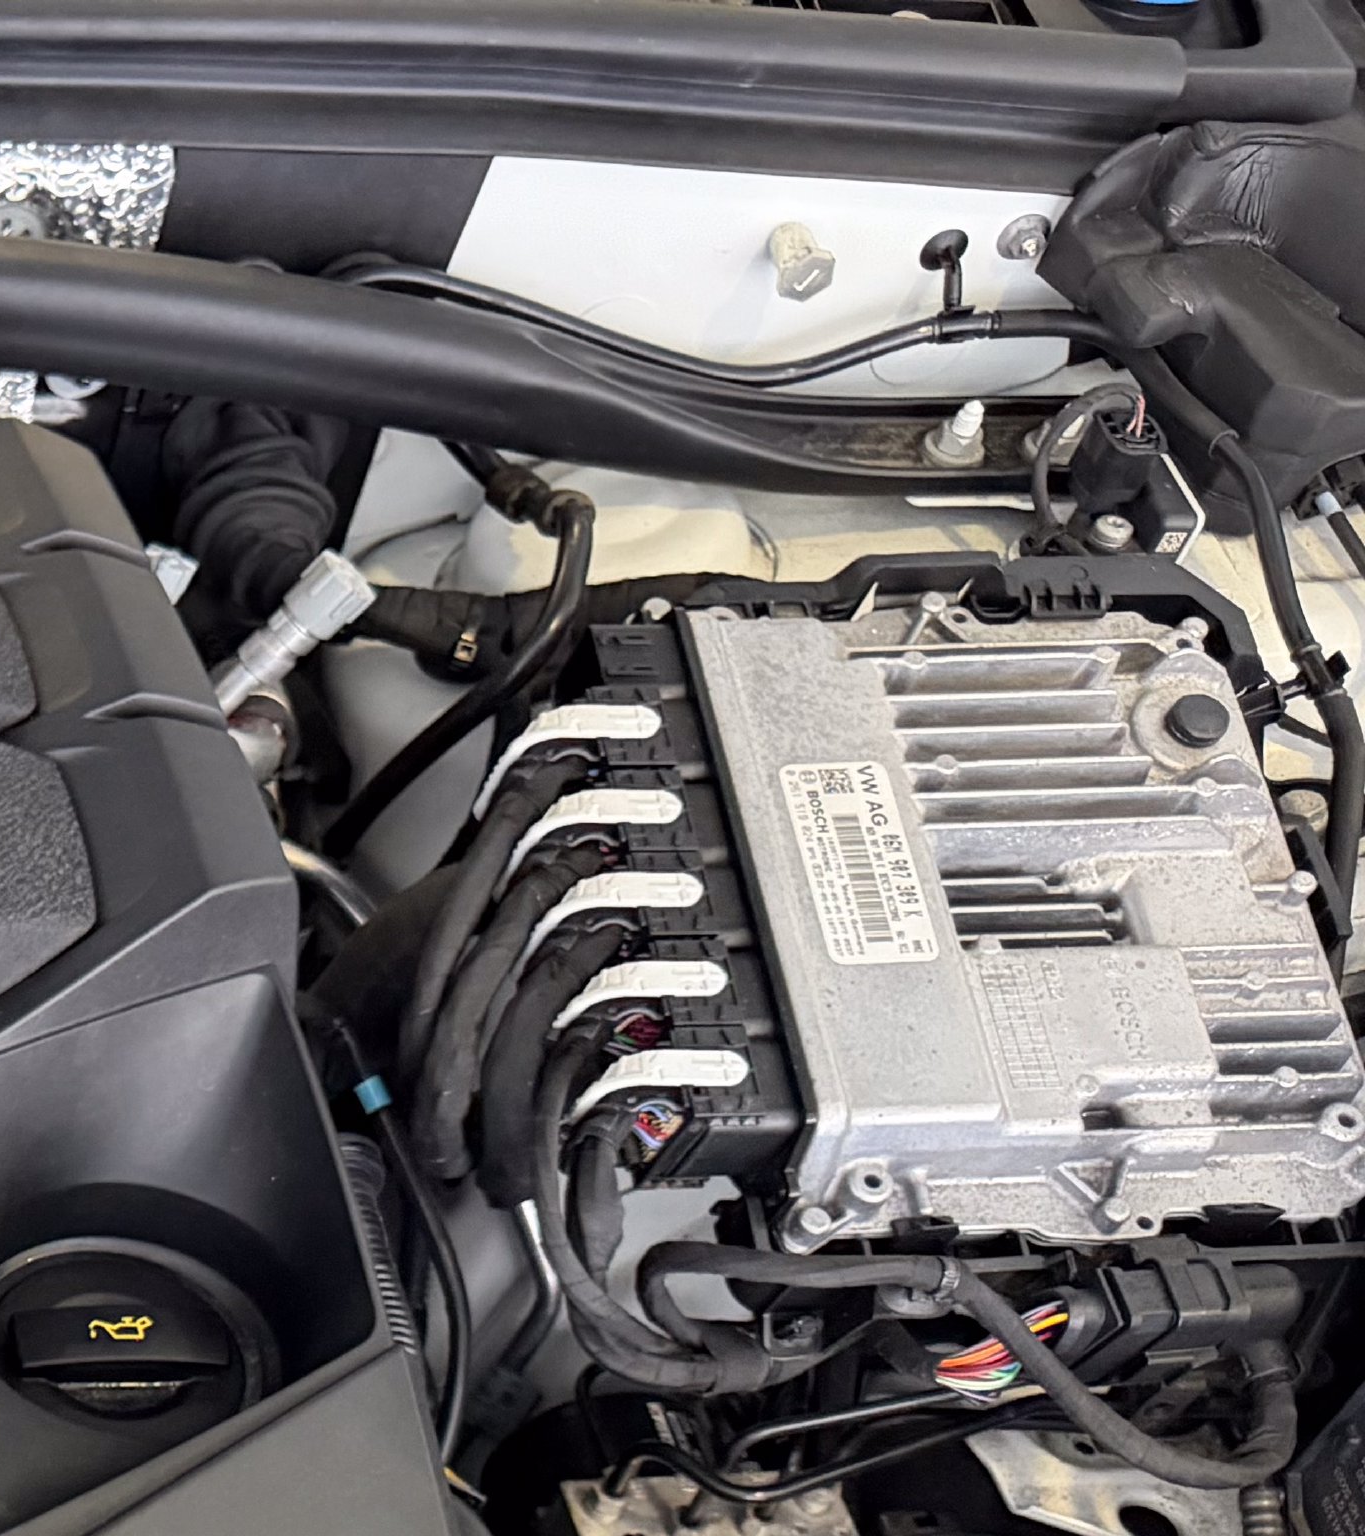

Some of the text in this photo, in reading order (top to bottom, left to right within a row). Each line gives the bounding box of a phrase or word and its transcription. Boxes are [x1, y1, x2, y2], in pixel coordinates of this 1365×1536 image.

[857, 765, 879, 795] VW
[807, 790, 829, 834] BOSCH
[865, 801, 888, 827] AG
[888, 860, 912, 878] 907
[896, 885, 919, 904] 309
[1111, 987, 1152, 1061] BOSCH
